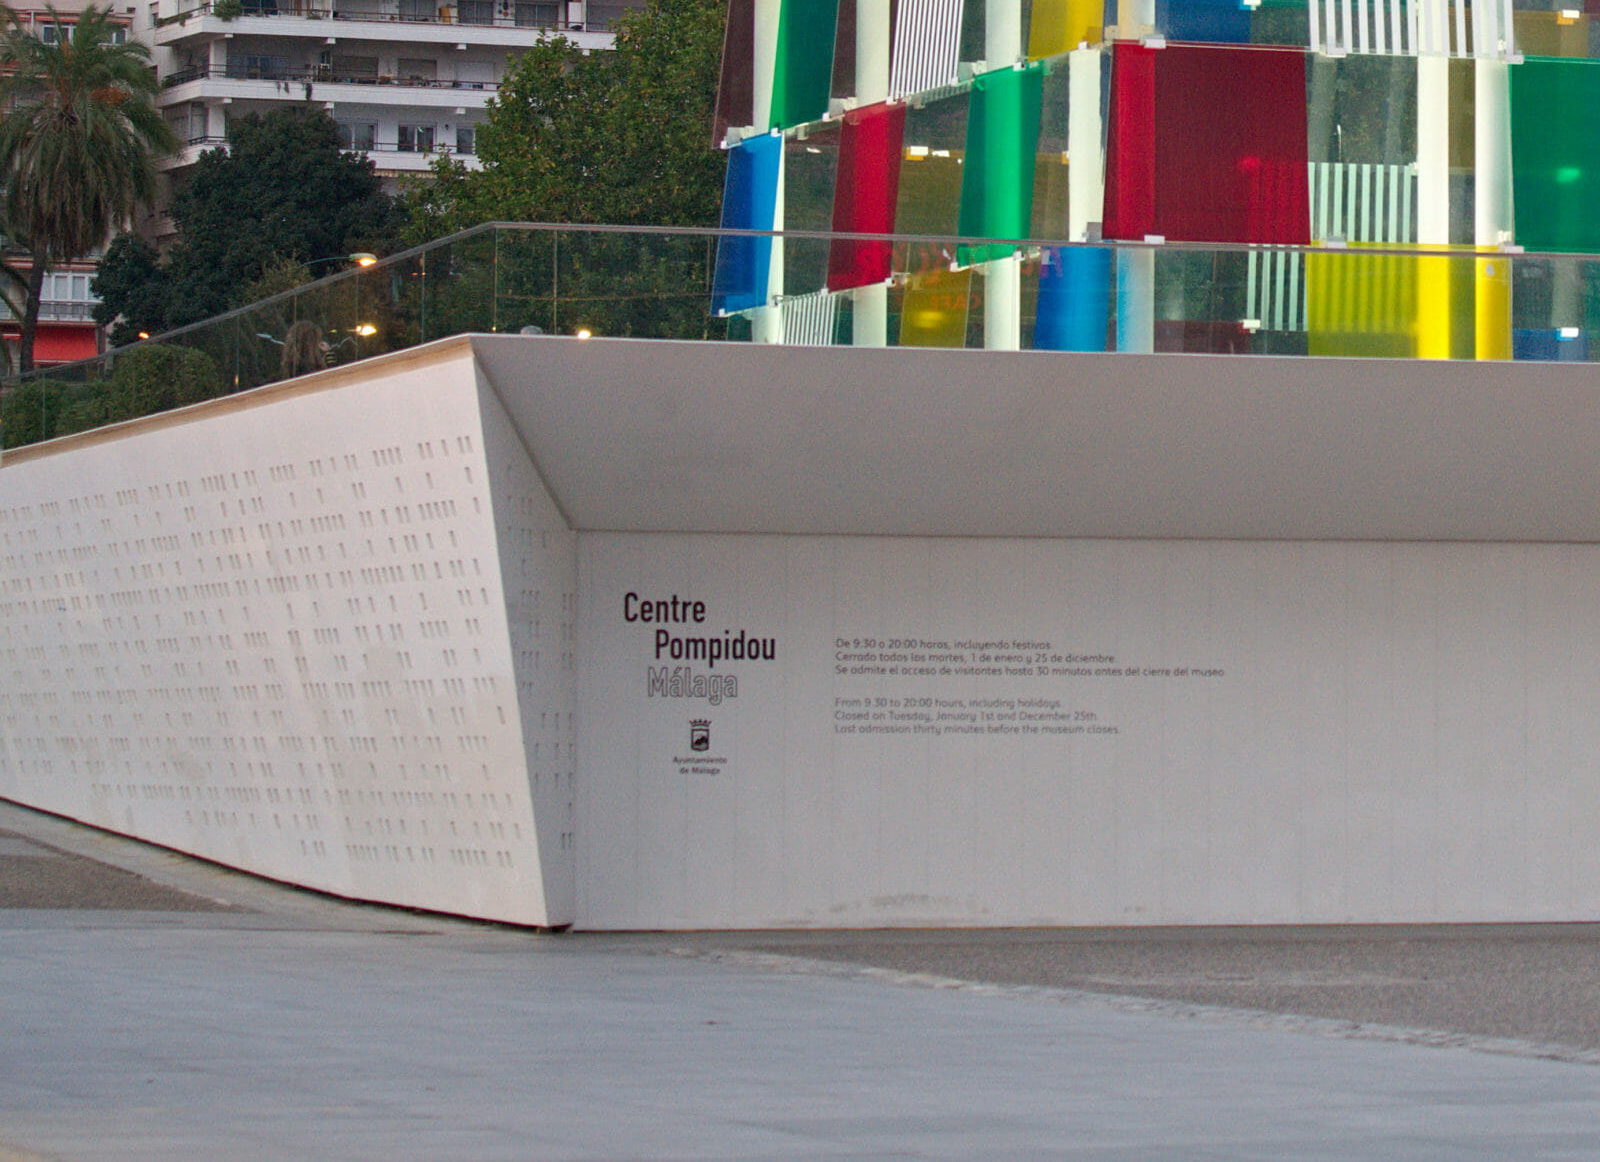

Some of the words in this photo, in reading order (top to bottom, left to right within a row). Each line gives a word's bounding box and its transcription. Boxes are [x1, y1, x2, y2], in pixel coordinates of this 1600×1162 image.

[624, 592, 706, 623] Centre
[655, 629, 775, 668] Pompidou
[647, 666, 738, 706] Málaga
